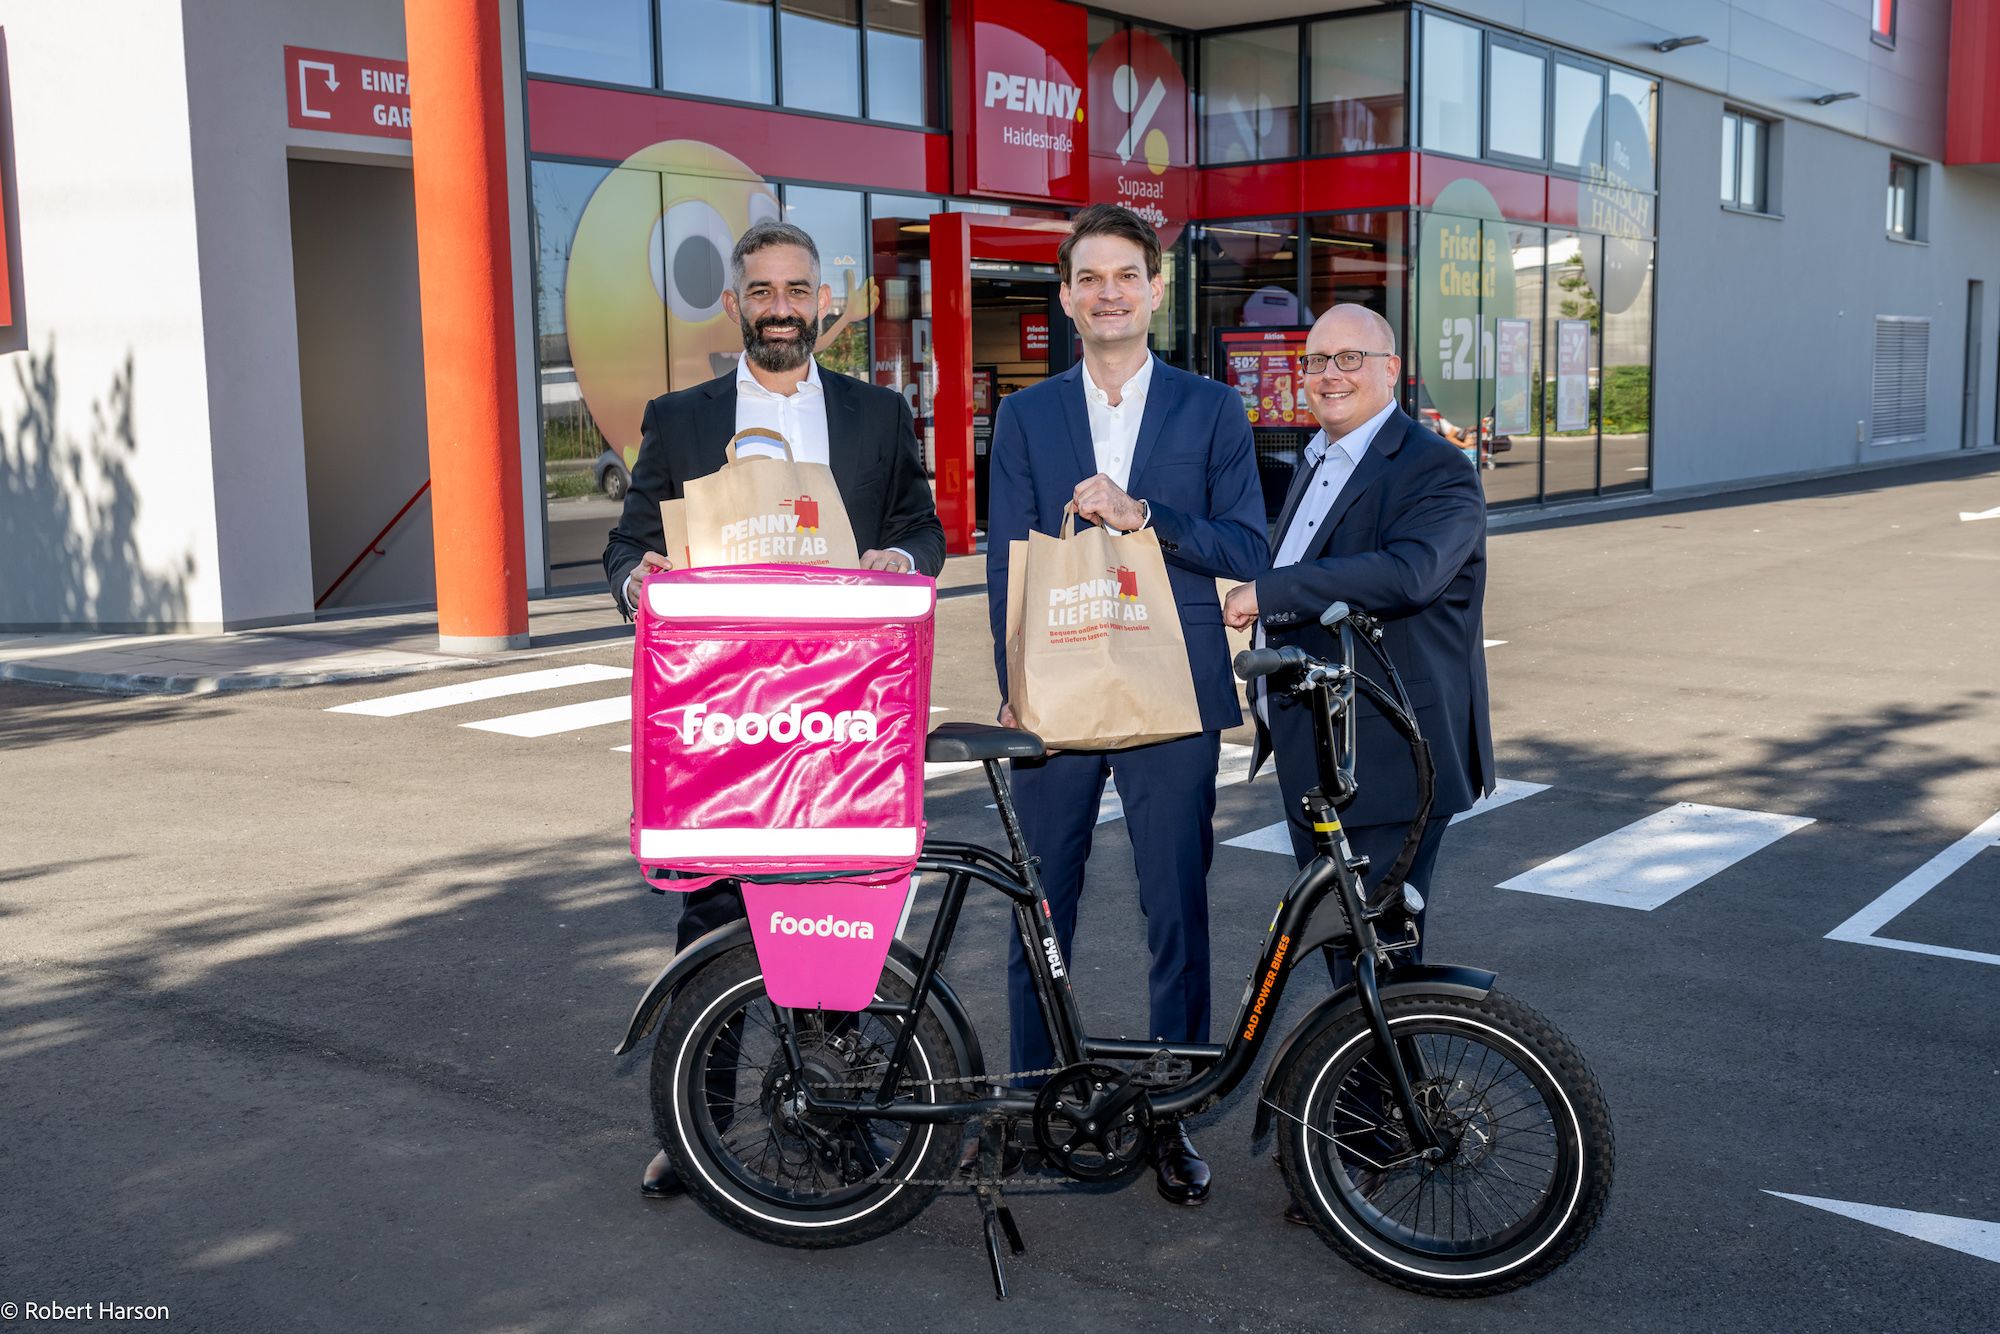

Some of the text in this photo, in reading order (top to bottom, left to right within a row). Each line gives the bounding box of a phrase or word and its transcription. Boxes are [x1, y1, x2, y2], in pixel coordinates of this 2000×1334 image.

[1003, 126, 1073, 153] Haidestraße
[1118, 175, 1164, 200] Supaaa!
[1587, 162, 1649, 229] FLEISCH
[1440, 224, 1496, 262] Frische
[1440, 262, 1496, 298] Check!
[1453, 313, 1495, 381] 2h
[721, 514, 800, 546] PENNY
[722, 537, 828, 563] LIEFERT AB
[1049, 579, 1122, 607] PENNY
[1048, 600, 1149, 627] LIEFERT AB
[1049, 629, 1078, 638] Bequem
[1078, 625, 1099, 635] online
[1050, 636, 1064, 645] und
[1065, 635, 1087, 644] liefern
[682, 703, 878, 745] foodora
[769, 911, 874, 940] foodora
[1042, 936, 1065, 979] CYCLE
[1243, 934, 1290, 1041] RAD POWER BIKES
